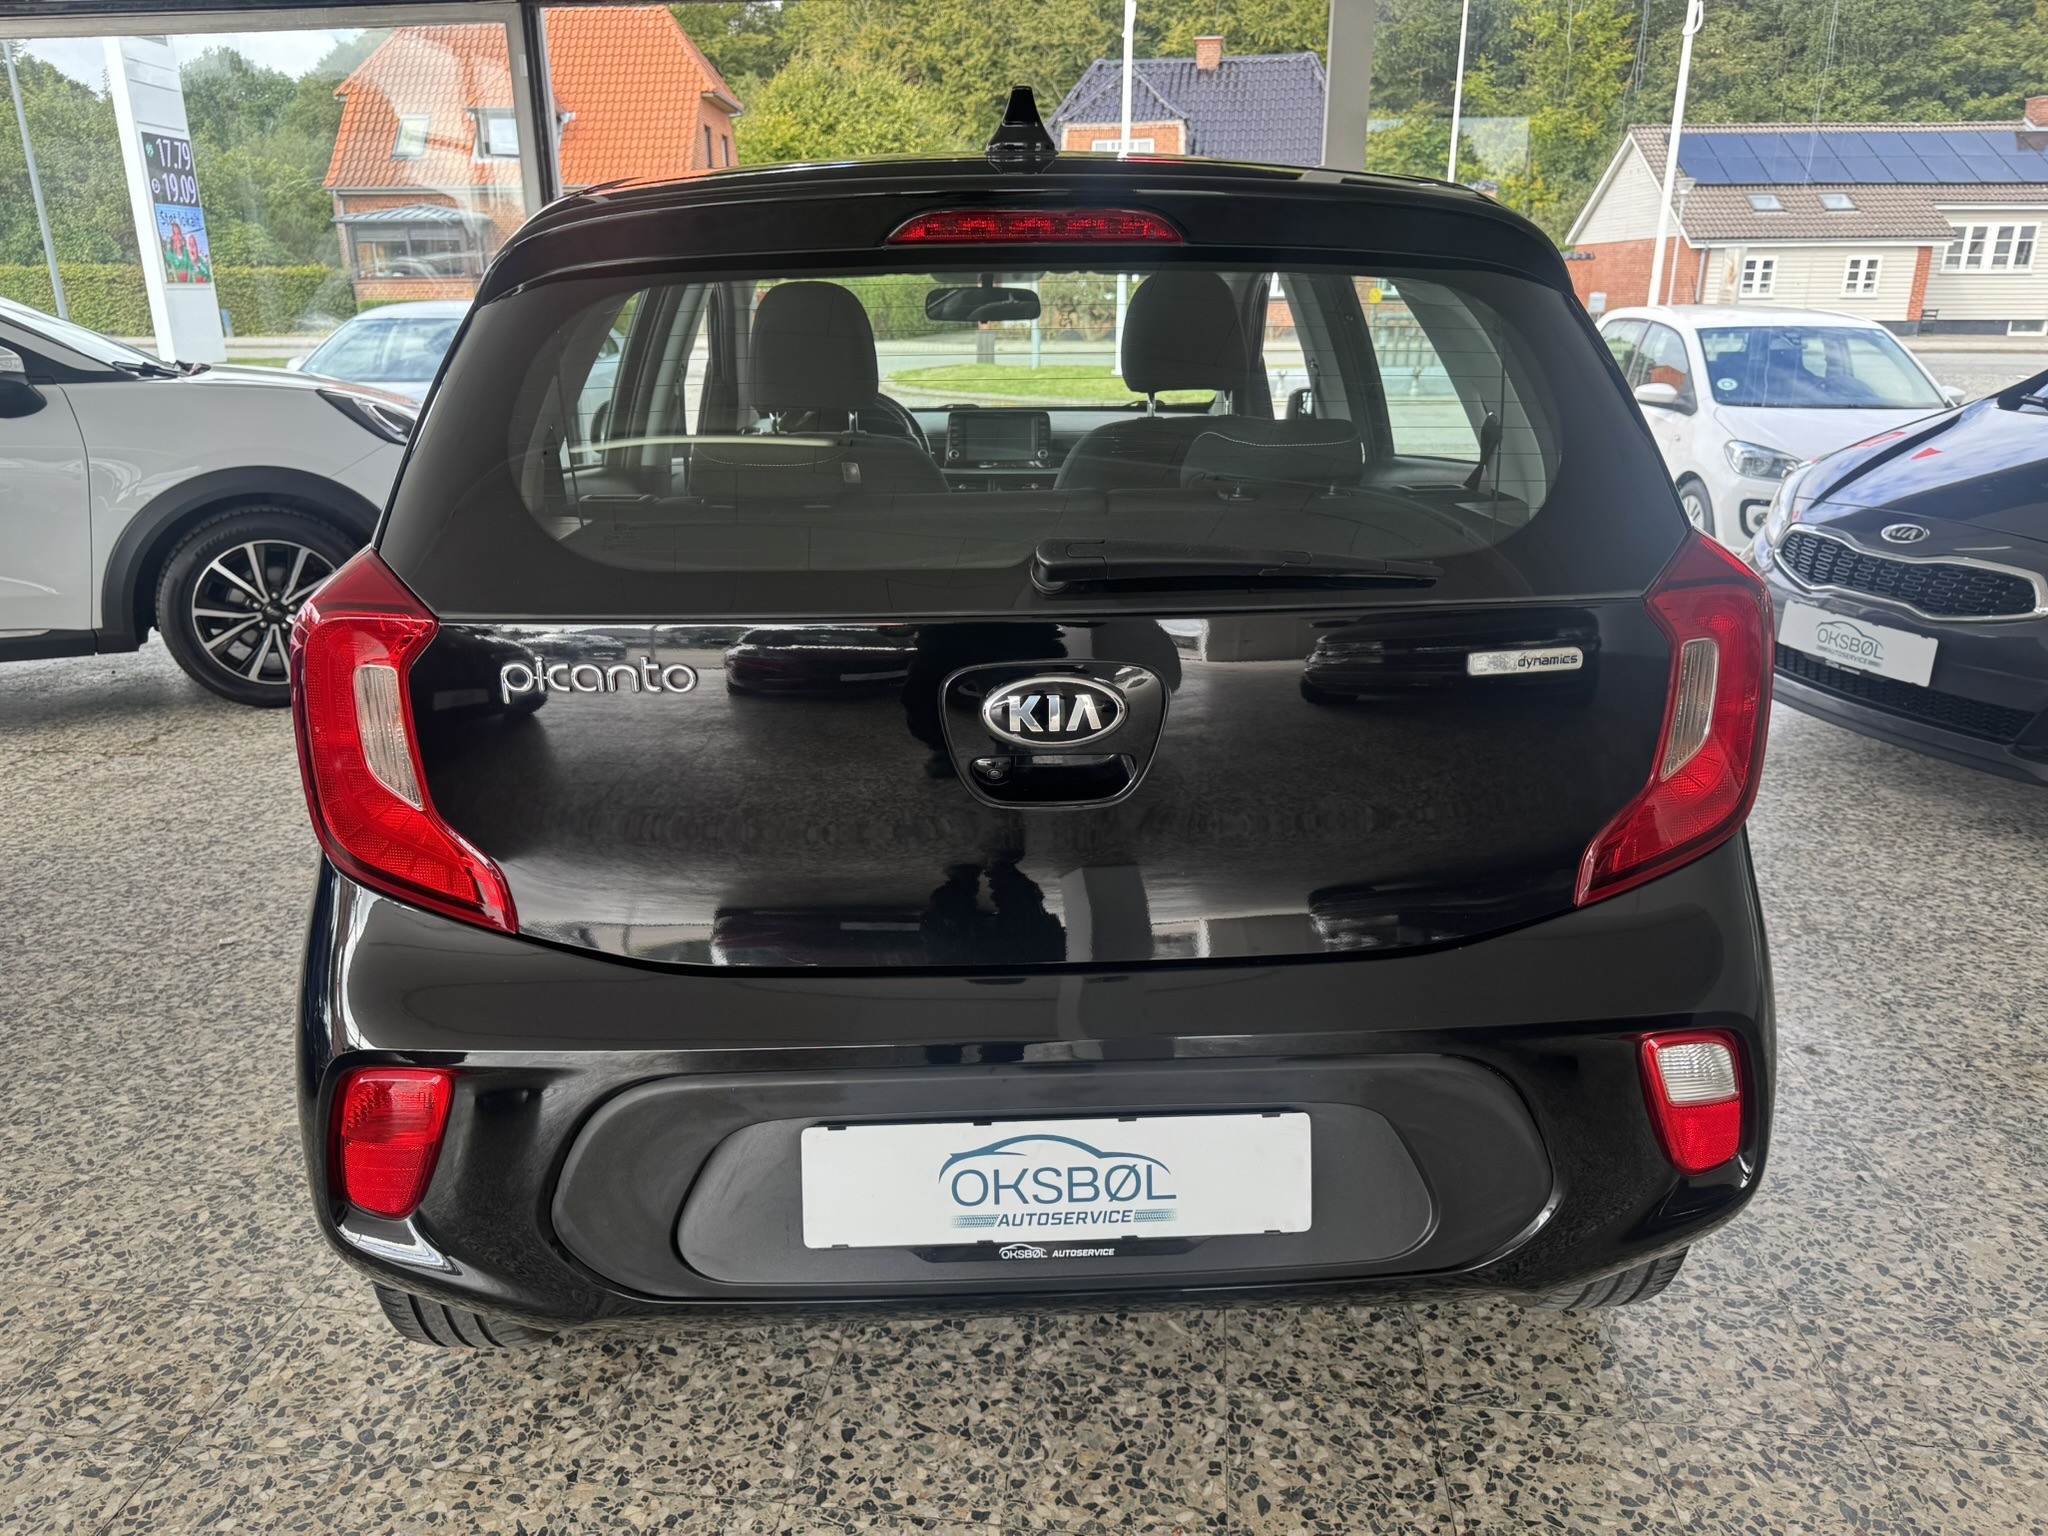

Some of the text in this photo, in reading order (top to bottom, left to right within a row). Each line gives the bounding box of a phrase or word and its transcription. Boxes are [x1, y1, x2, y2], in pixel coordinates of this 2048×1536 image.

[156, 138, 191, 170] 17.79
[162, 173, 197, 204] 19.09
[1817, 628, 1884, 660] OKSBØL
[1517, 654, 1578, 669] dynamics
[501, 656, 697, 704] picanto
[1008, 694, 1102, 732] KIA
[951, 1164, 1177, 1207] OKSBØL
[997, 1209, 1133, 1227] AUTOSERVICE
[1000, 1248, 1115, 1260] OKSBØL AUTOSERVICE
